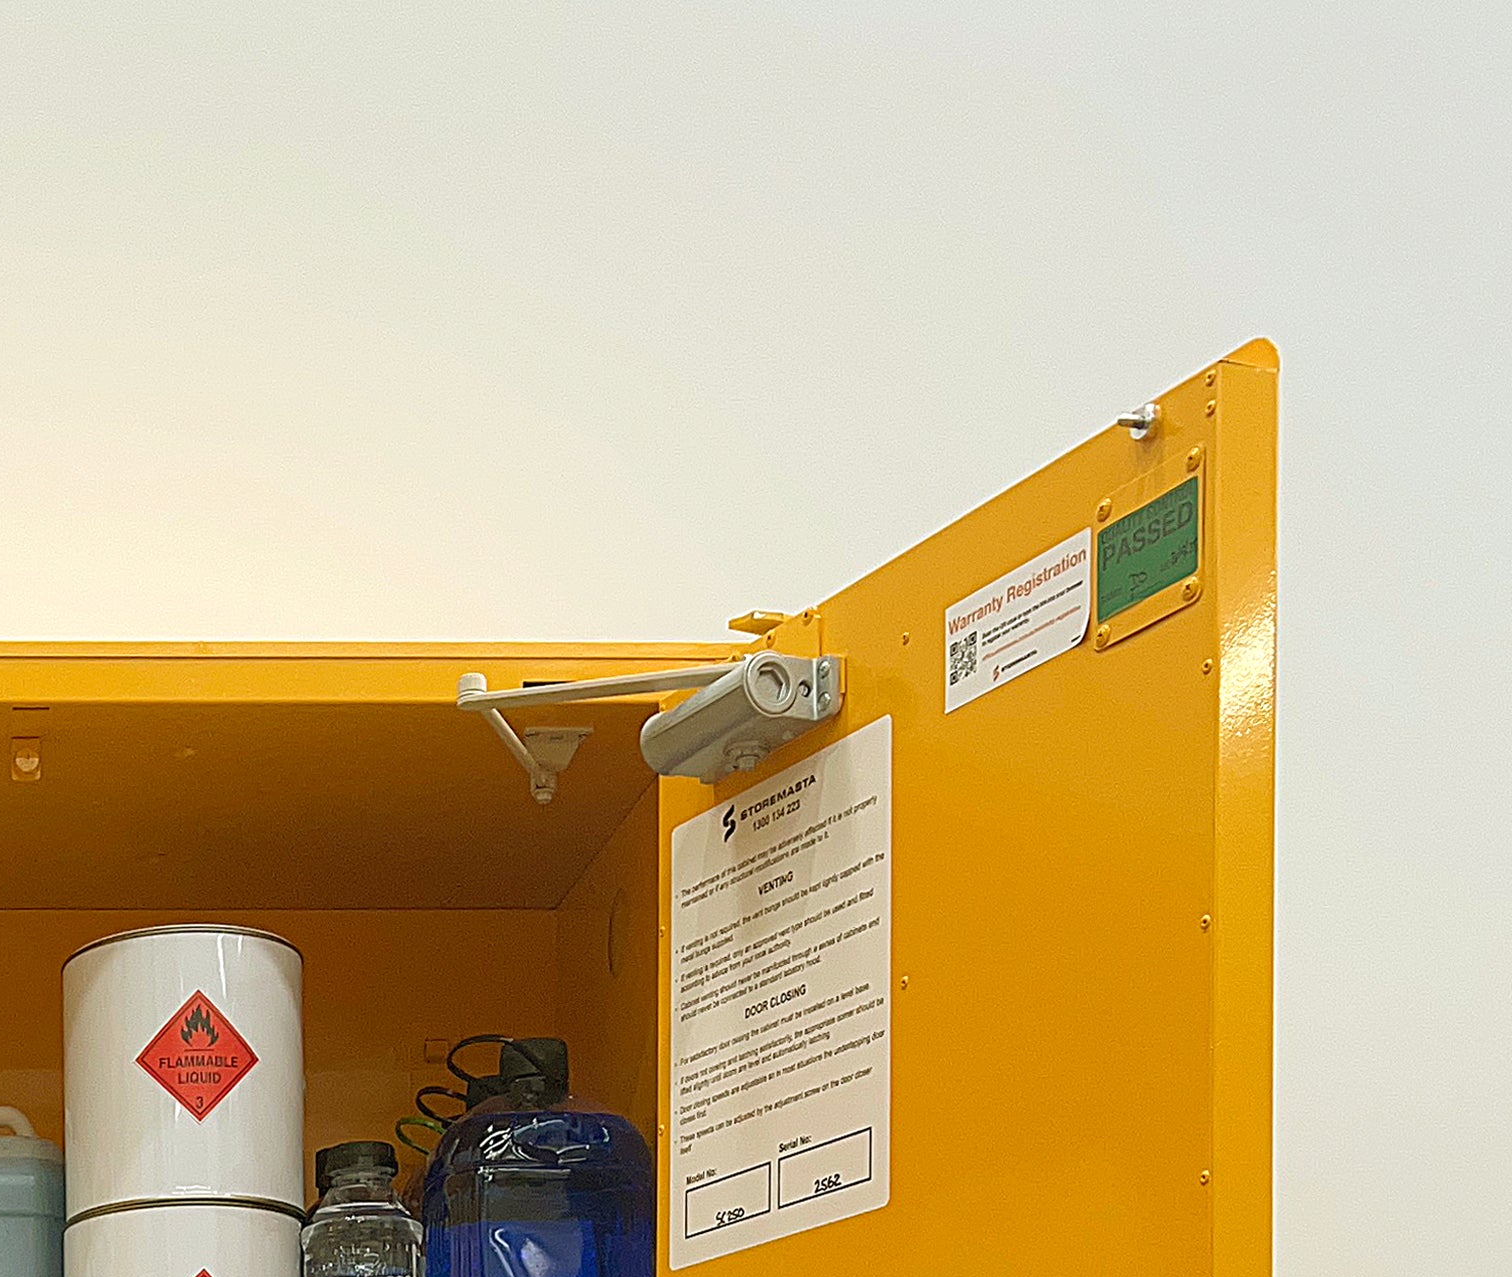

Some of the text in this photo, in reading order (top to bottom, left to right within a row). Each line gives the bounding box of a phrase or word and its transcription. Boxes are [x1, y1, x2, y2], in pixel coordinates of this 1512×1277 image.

[1102, 501, 1193, 571] PASSED
[948, 592, 1004, 635] Warranty
[1006, 549, 1087, 607] Registration
[740, 774, 816, 821] STOREMASTA
[753, 799, 800, 832] 1300 134 223
[758, 870, 794, 896] VENTING
[744, 984, 806, 1019] DOOR CLOSING
[158, 1055, 239, 1069] FLAMMABLE
[178, 1071, 222, 1084] LIQUID
[195, 1096, 204, 1109] 3
[778, 1135, 812, 1153] Serial No:
[686, 1168, 717, 1185] Model No:
